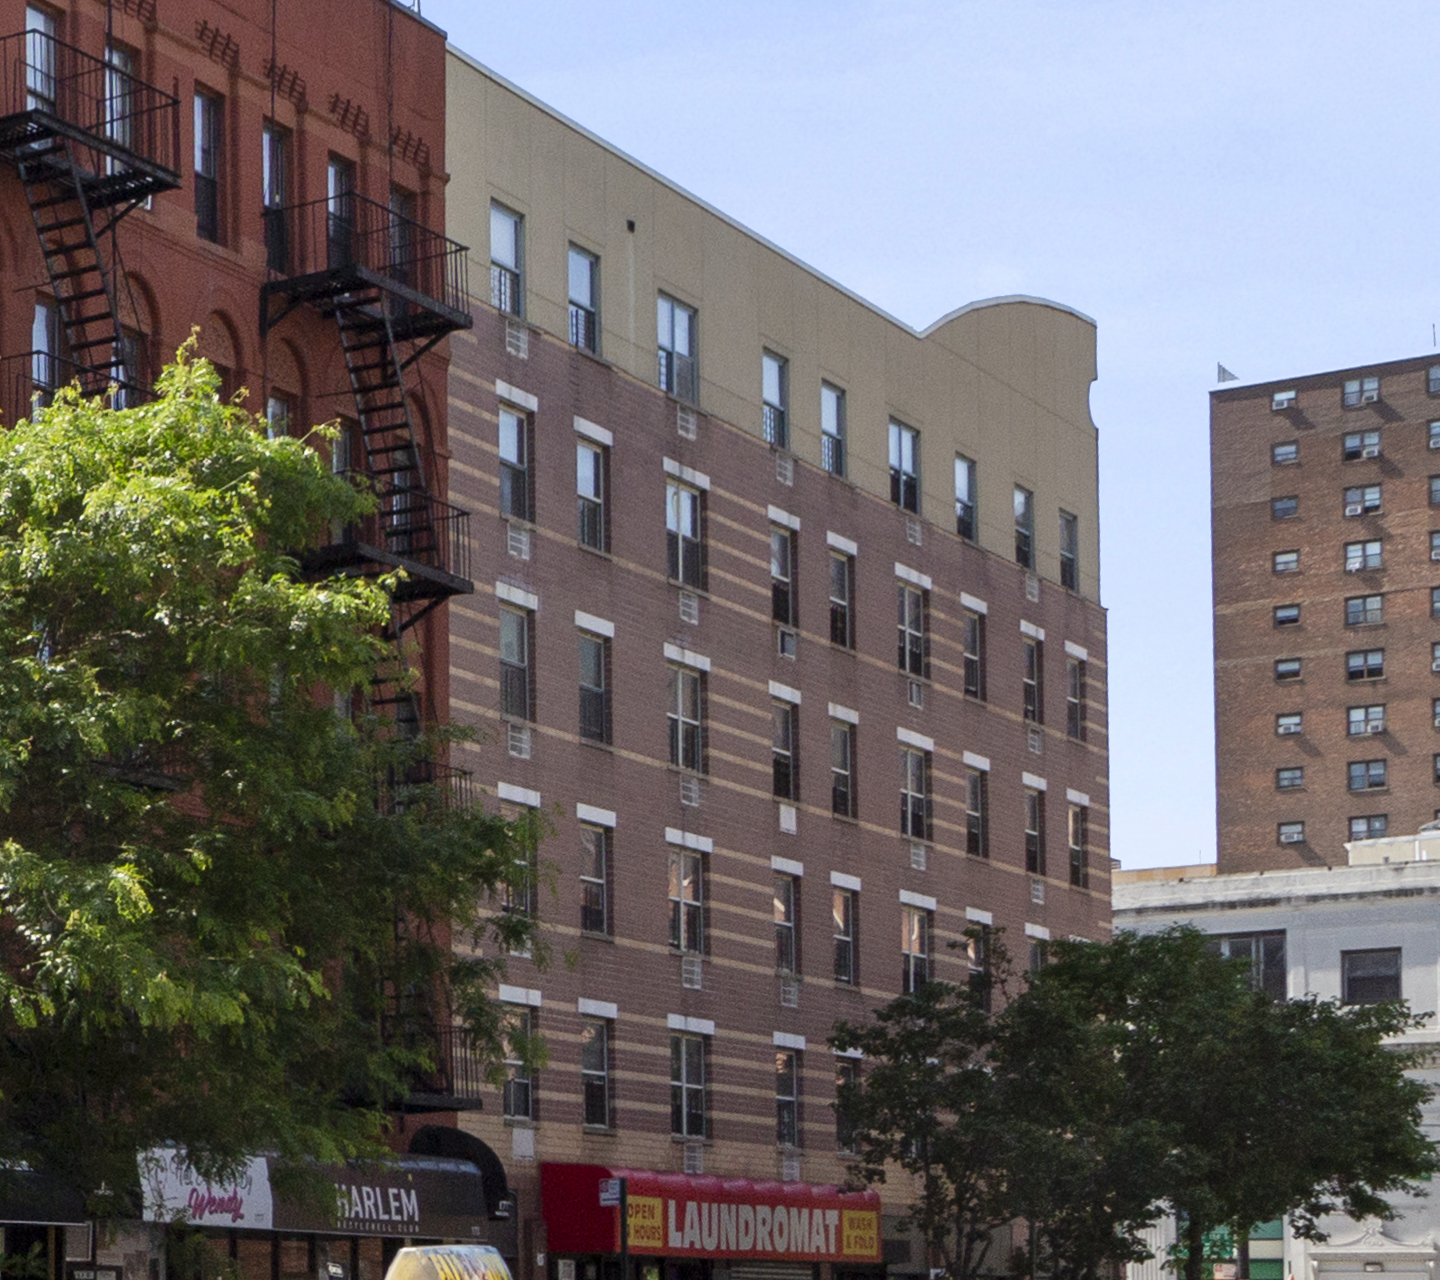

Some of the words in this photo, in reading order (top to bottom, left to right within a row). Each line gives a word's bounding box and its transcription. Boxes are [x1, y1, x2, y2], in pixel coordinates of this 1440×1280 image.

[188, 1187, 245, 1223] Wendy
[334, 1183, 419, 1222] HARLEM
[626, 1203, 656, 1220] OPEN
[634, 1225, 661, 1240] HOURS
[668, 1199, 840, 1254] LAUNDROMAT
